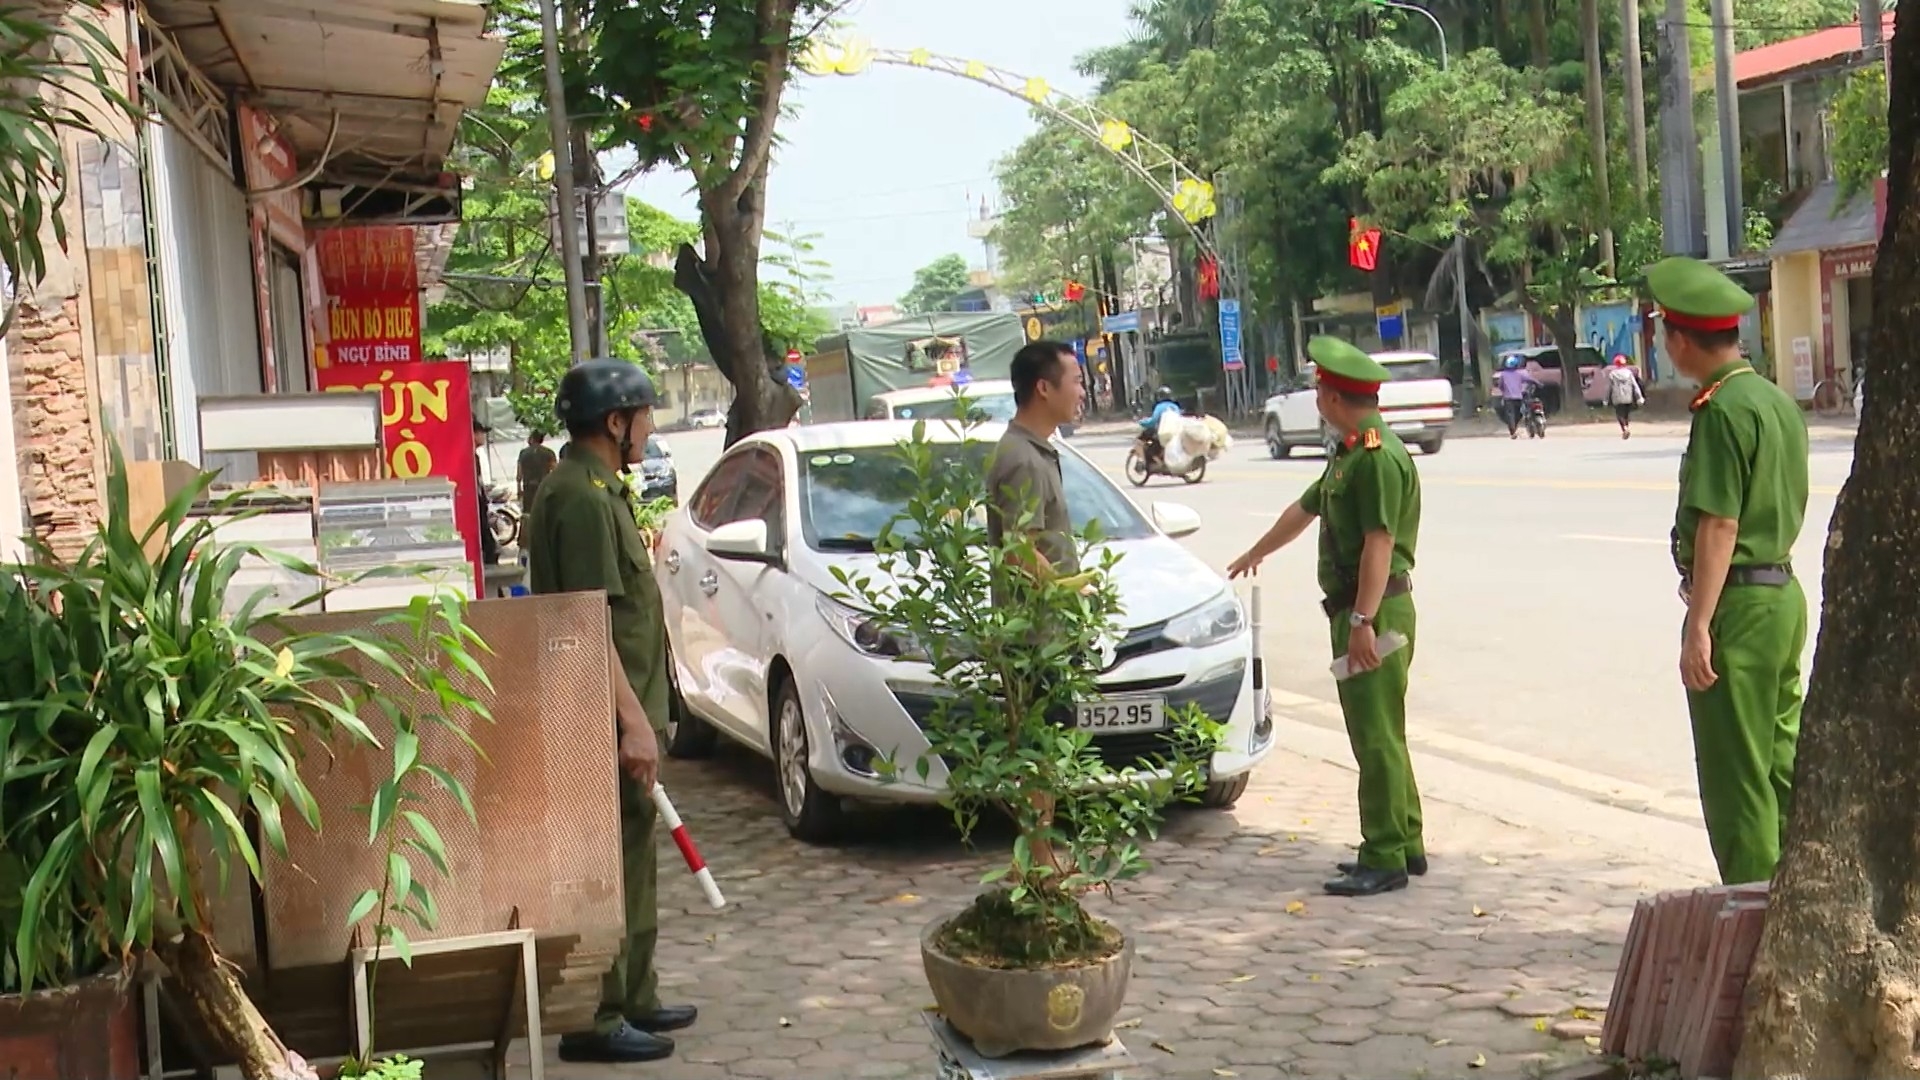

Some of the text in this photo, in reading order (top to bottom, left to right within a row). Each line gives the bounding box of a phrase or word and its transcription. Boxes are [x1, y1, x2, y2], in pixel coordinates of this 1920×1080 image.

[331, 292, 414, 340] BÚN BÒ HUẾ
[338, 345, 371, 366] NGỰ
[325, 370, 450, 427] ÚN
[384, 428, 432, 478] Ò
